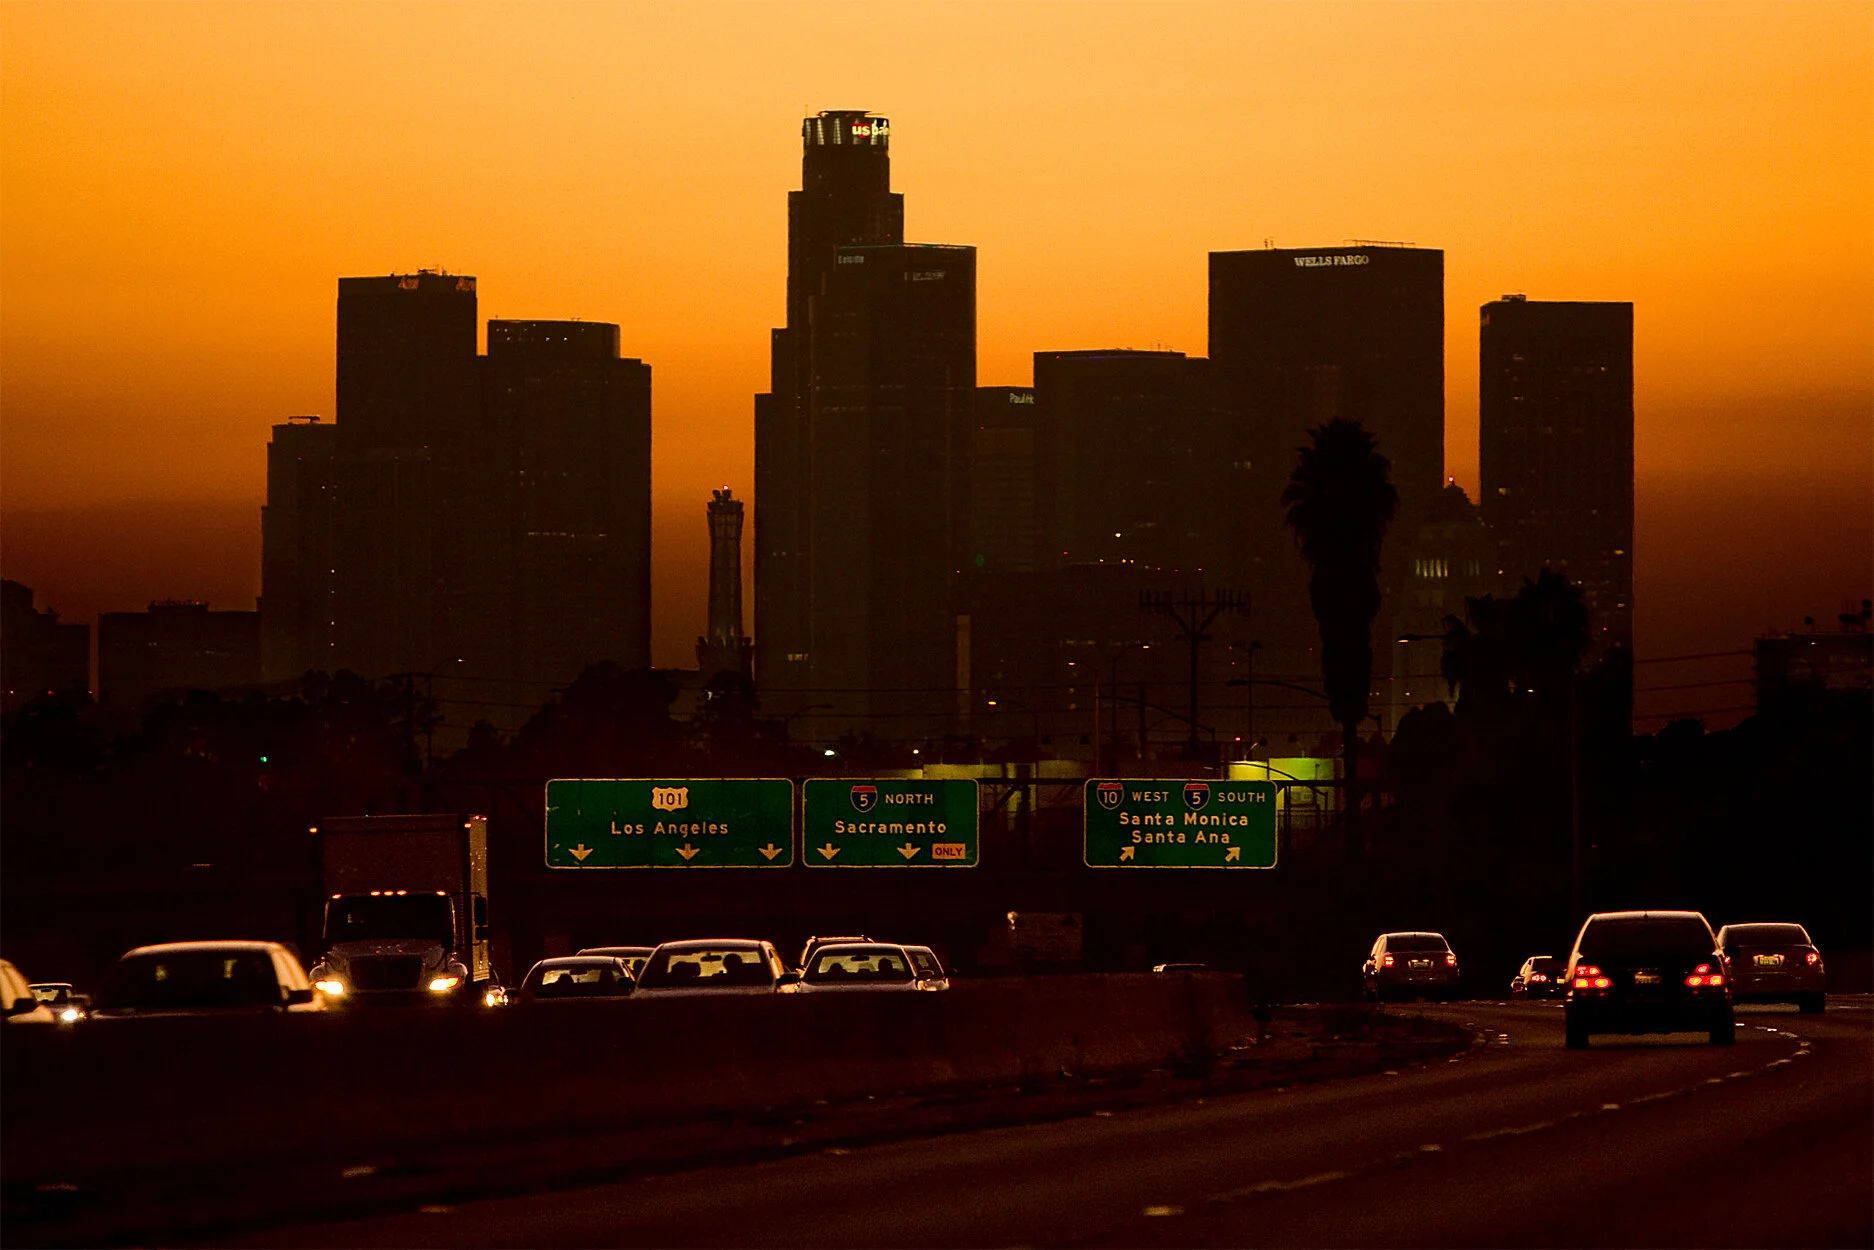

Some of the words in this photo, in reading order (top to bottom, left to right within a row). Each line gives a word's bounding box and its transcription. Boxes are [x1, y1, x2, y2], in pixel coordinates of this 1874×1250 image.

[1294, 256, 1332, 267] WELLS
[1333, 255, 1369, 266] FARGO
[658, 792, 682, 806] 101
[860, 794, 869, 807] 5
[885, 793, 933, 804] NORTH
[1103, 791, 1118, 804] 10
[1132, 791, 1169, 801] WEST
[1192, 792, 1201, 805] 5
[1218, 792, 1265, 802] SOUTH
[1119, 812, 1174, 826] Santa
[1184, 812, 1248, 826] Monica
[611, 821, 644, 835] Los
[654, 821, 729, 838] Angeles
[835, 820, 947, 834] Sacramento
[1132, 830, 1186, 844] Santa
[1195, 830, 1230, 844] Ana
[935, 847, 962, 857] ONLY
